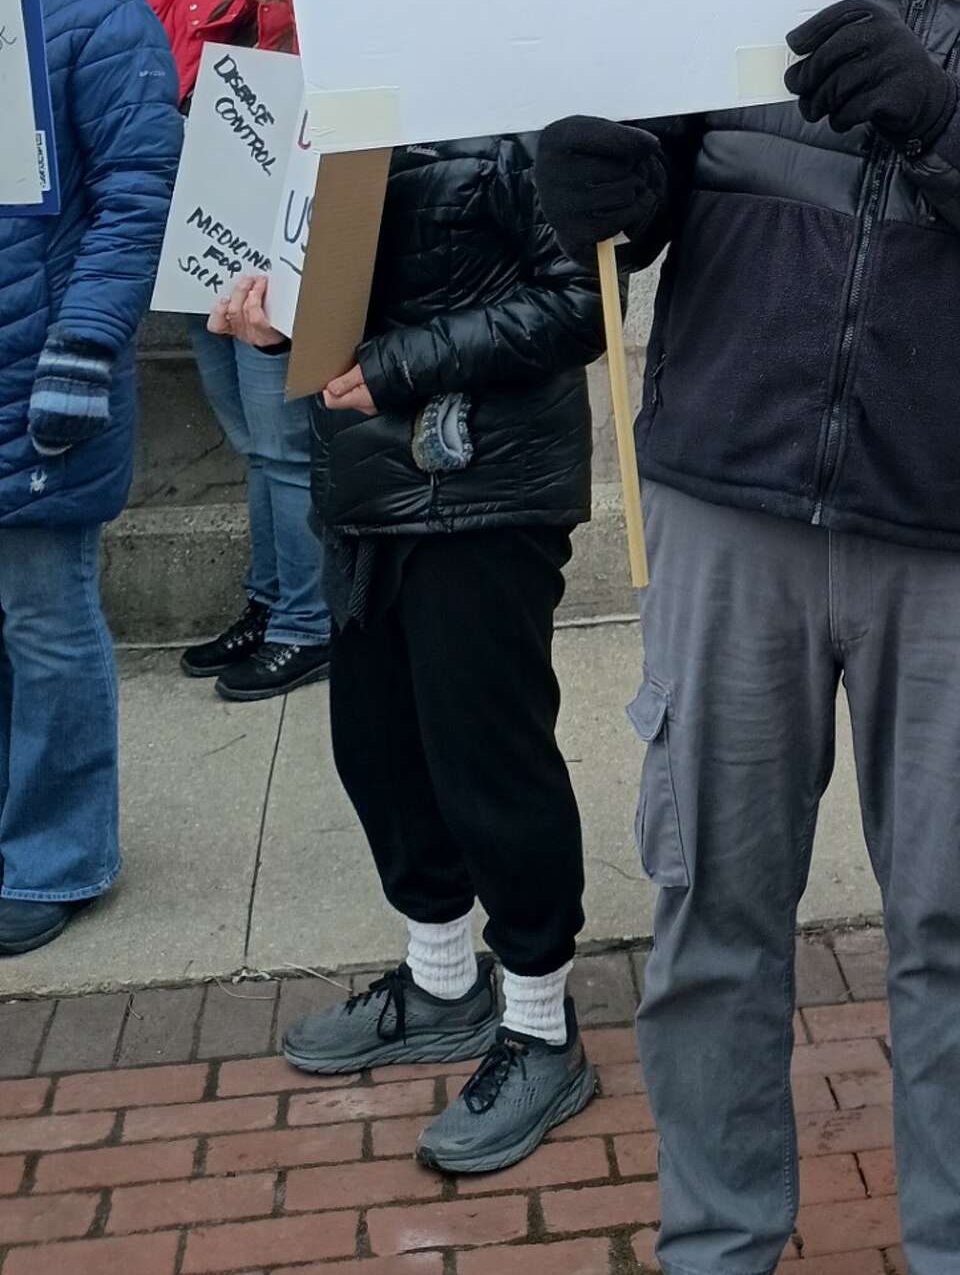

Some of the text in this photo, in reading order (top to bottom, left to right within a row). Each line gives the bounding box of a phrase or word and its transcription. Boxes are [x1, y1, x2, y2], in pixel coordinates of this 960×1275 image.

[213, 54, 275, 126] DISEASE
[215, 97, 276, 177] CONTROL
[186, 206, 272, 272] MEDICINE
[203, 245, 242, 279] FOR
[178, 256, 224, 294] SICK
